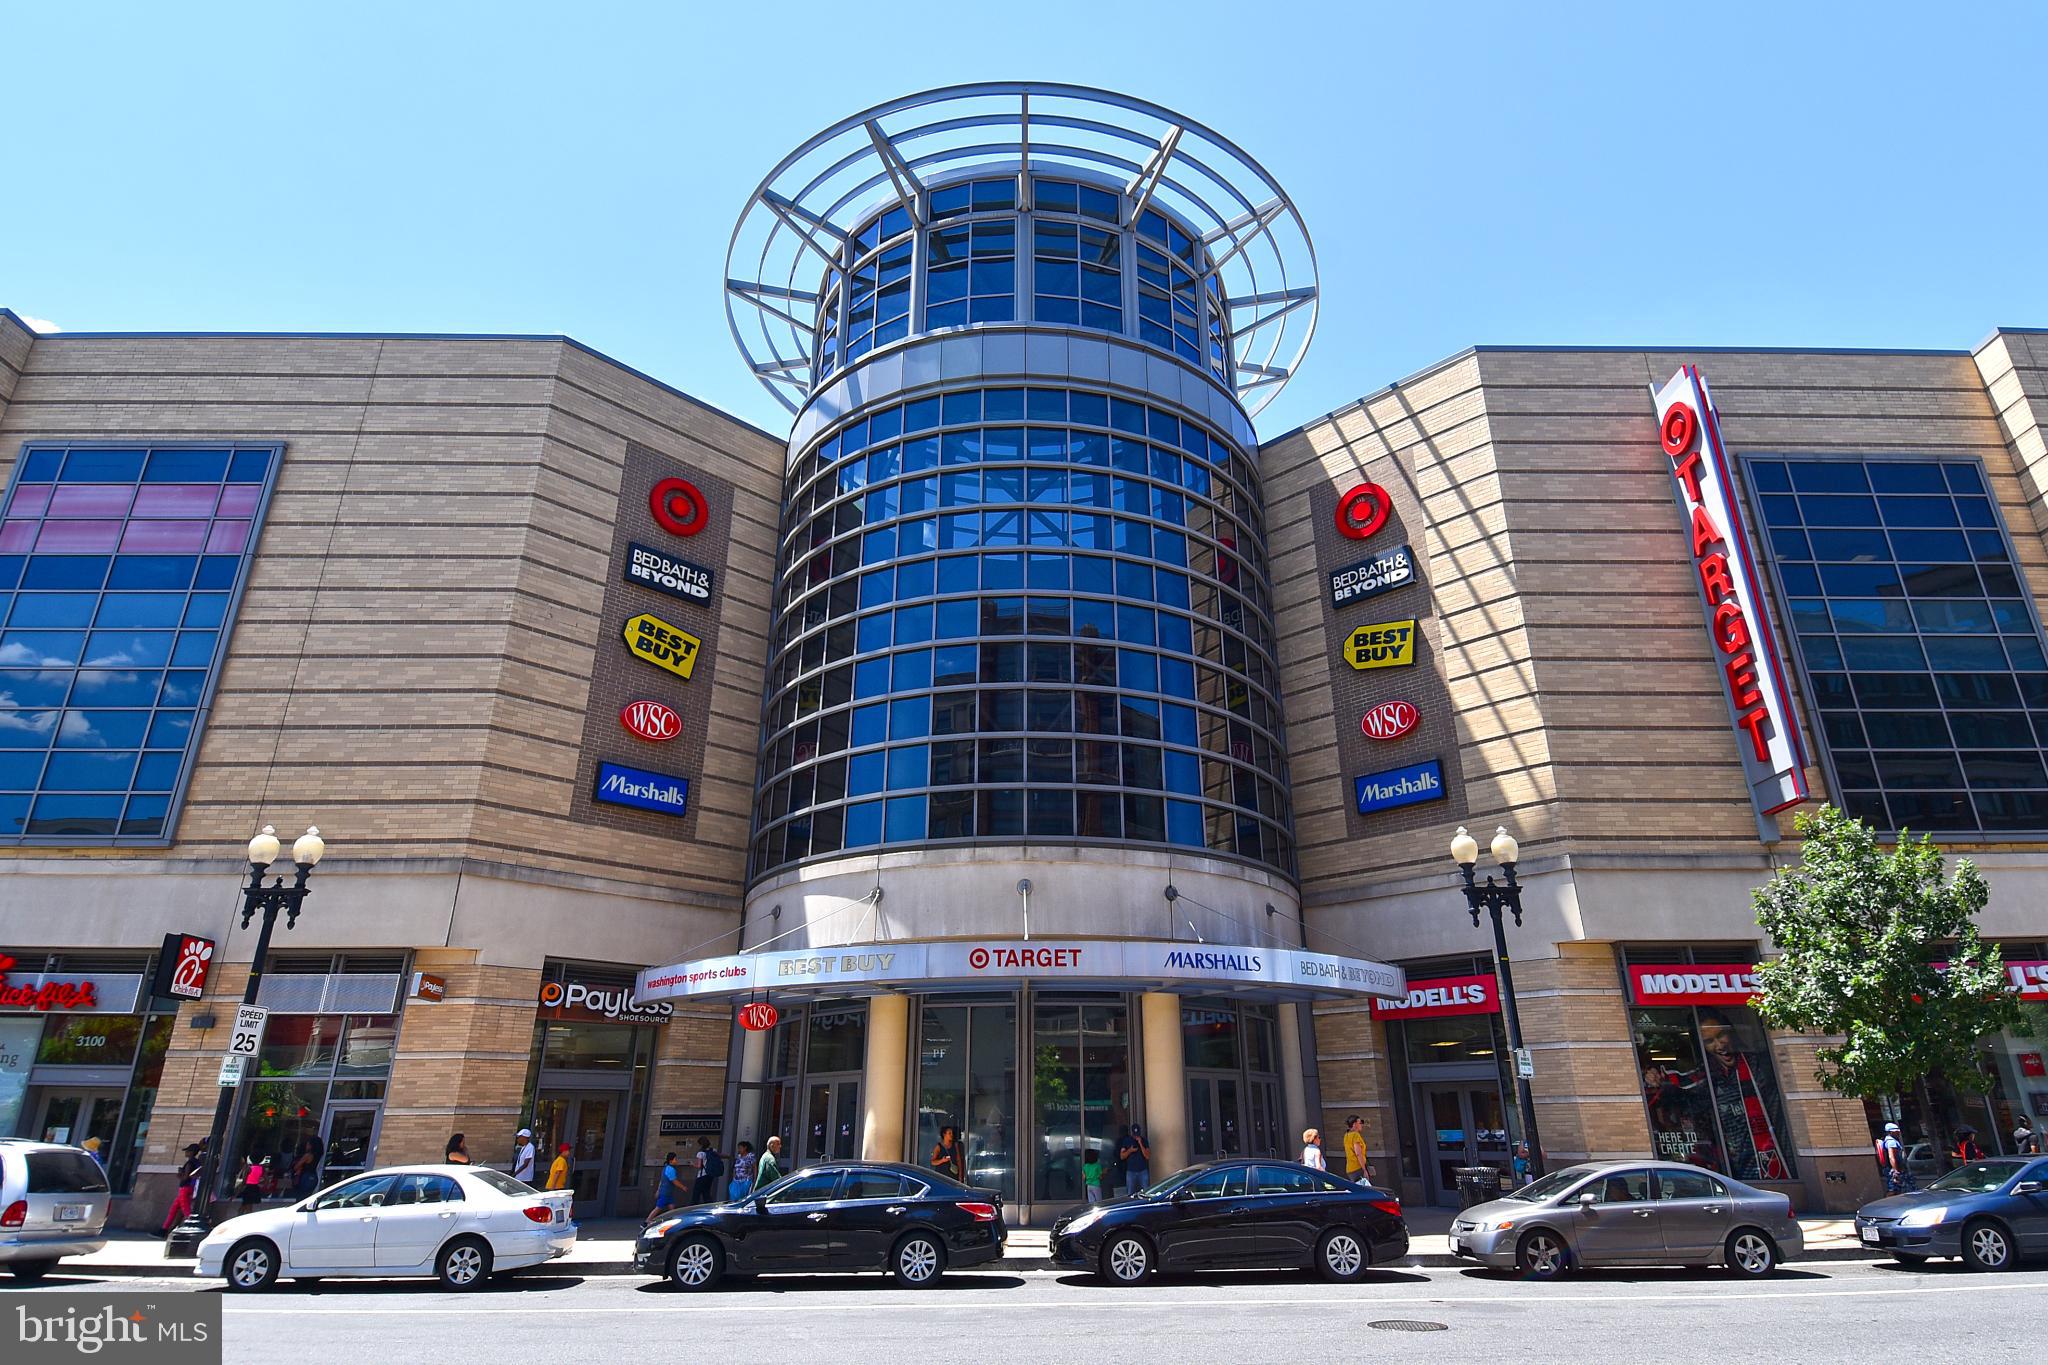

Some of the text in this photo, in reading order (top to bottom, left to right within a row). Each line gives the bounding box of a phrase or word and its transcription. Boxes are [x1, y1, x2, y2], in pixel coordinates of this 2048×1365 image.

[632, 548, 709, 588] BED BATH &
[1332, 553, 1408, 590] BED BATH &
[631, 563, 709, 598] BEYOND
[1334, 568, 1410, 602] BEYOND
[1674, 452, 1770, 763] TARGET
[638, 619, 696, 655] BEST
[1354, 627, 1411, 647] BEST
[636, 635, 688, 667] BUY
[1356, 644, 1405, 663] BUY
[632, 703, 674, 736] WSC
[1366, 704, 1409, 736] WSC
[601, 774, 684, 806] Marshalls
[1361, 772, 1439, 804] Marshalls
[778, 953, 896, 977] BEST BUY
[992, 948, 1082, 967] TARGET
[1164, 952, 1262, 972] MARSHALLS
[647, 966, 747, 989] washington sports clubs
[1300, 960, 1318, 975] BED
[1319, 963, 1341, 980] BATH
[1348, 967, 1395, 987] BEYOND
[240, 1009, 264, 1020] SPEED
[240, 1019, 259, 1029] LIMIT
[619, 1014, 669, 1023] SHOESOURCE
[749, 1005, 775, 1028] WSC
[76, 1035, 106, 1047] 3100
[233, 1033, 257, 1052] 25
[664, 1121, 719, 1129] PERFUMANIA
[1658, 1132, 1698, 1143] HERE TO
[1660, 1143, 1697, 1154] CREATE
